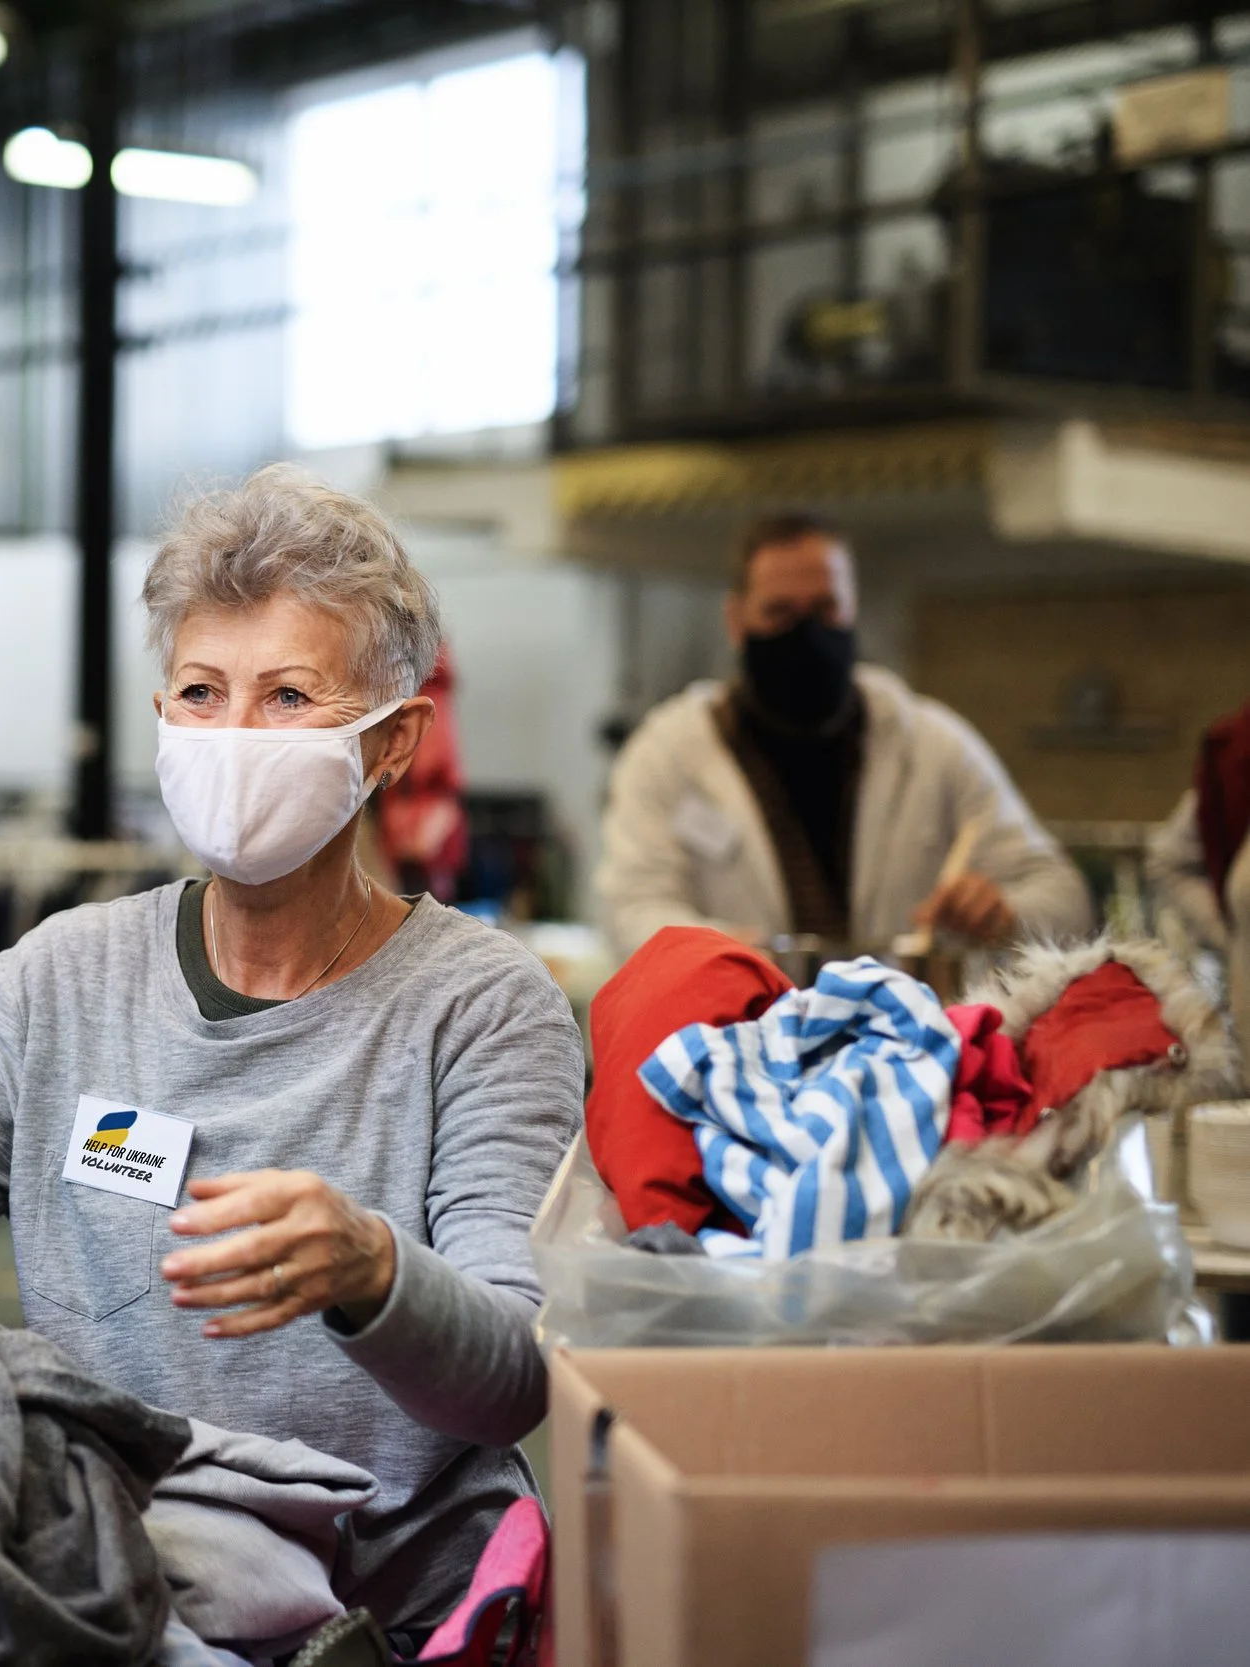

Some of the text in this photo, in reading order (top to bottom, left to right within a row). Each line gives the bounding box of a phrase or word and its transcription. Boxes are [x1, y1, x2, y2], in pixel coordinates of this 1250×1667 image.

[83, 1138, 166, 1168] HELP FOR UKRAINE
[81, 1154, 152, 1183] VOLUNTEER
